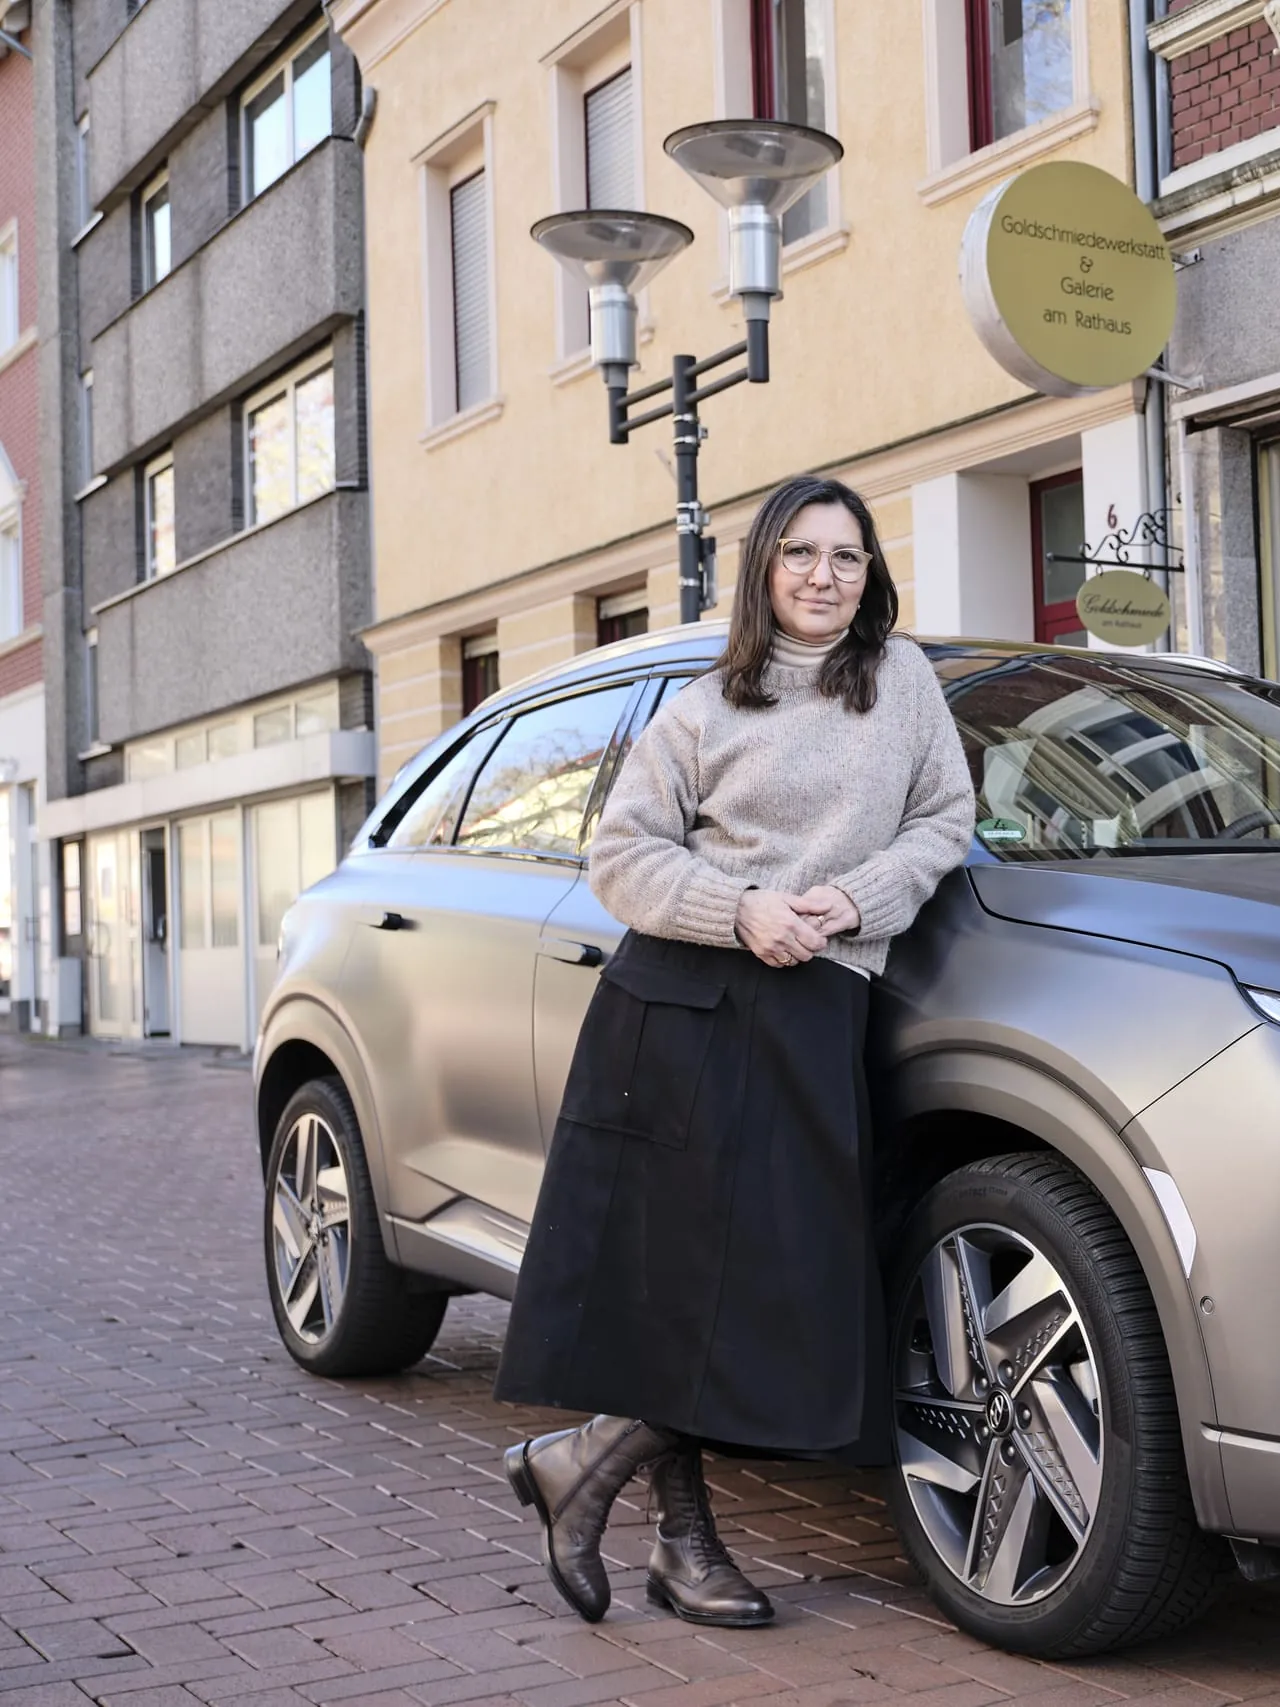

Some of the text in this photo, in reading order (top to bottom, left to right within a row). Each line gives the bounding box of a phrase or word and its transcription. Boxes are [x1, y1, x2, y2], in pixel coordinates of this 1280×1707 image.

[1001, 215, 1166, 260] Goldschmiedewerkstatt
[1079, 256, 1094, 273] &
[1060, 277, 1115, 302] Galerie
[1043, 308, 1132, 335] am Rathaus
[1107, 504, 1117, 528] 6
